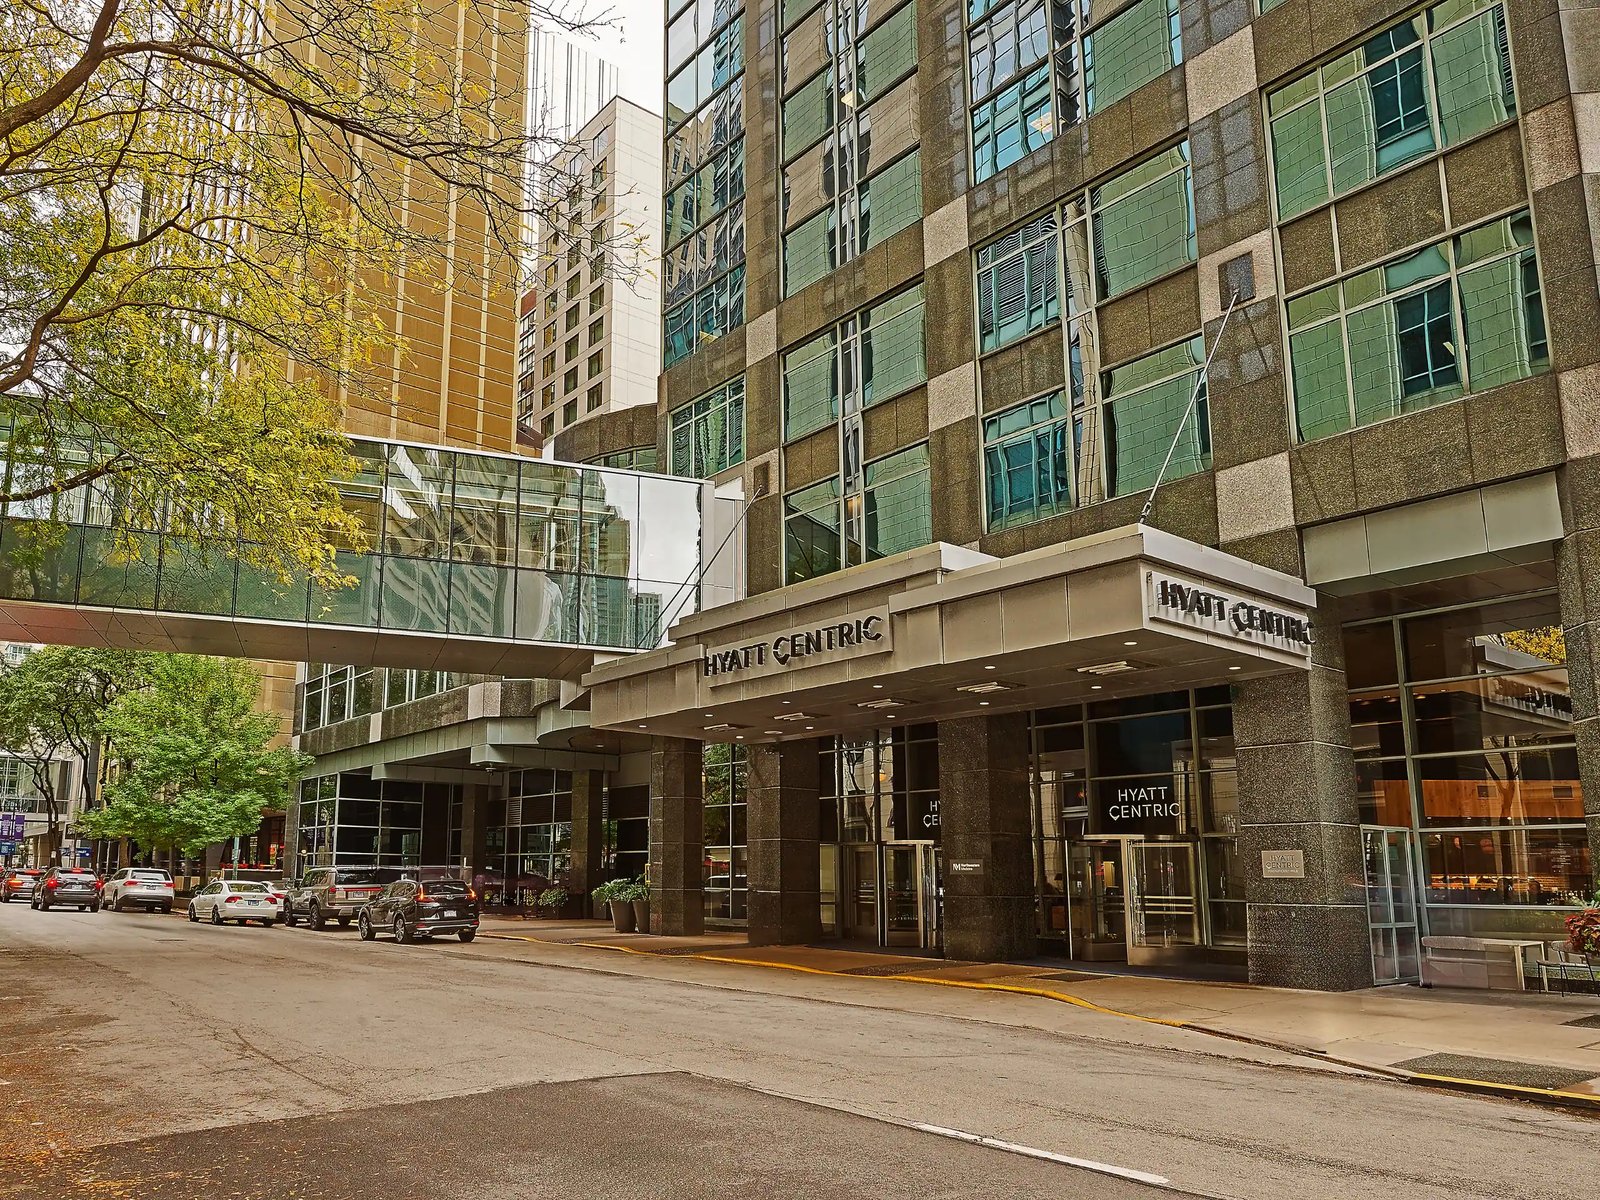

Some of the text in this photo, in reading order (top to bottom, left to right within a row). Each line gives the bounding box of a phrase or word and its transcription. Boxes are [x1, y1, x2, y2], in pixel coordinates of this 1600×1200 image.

[1158, 580, 1317, 645] HYATT CENTRIC
[703, 615, 884, 677] HYATT CENTRIC
[1118, 786, 1168, 802] HYATT
[1109, 802, 1182, 821] CENTRIC
[1265, 861, 1300, 870] CENTRIC
